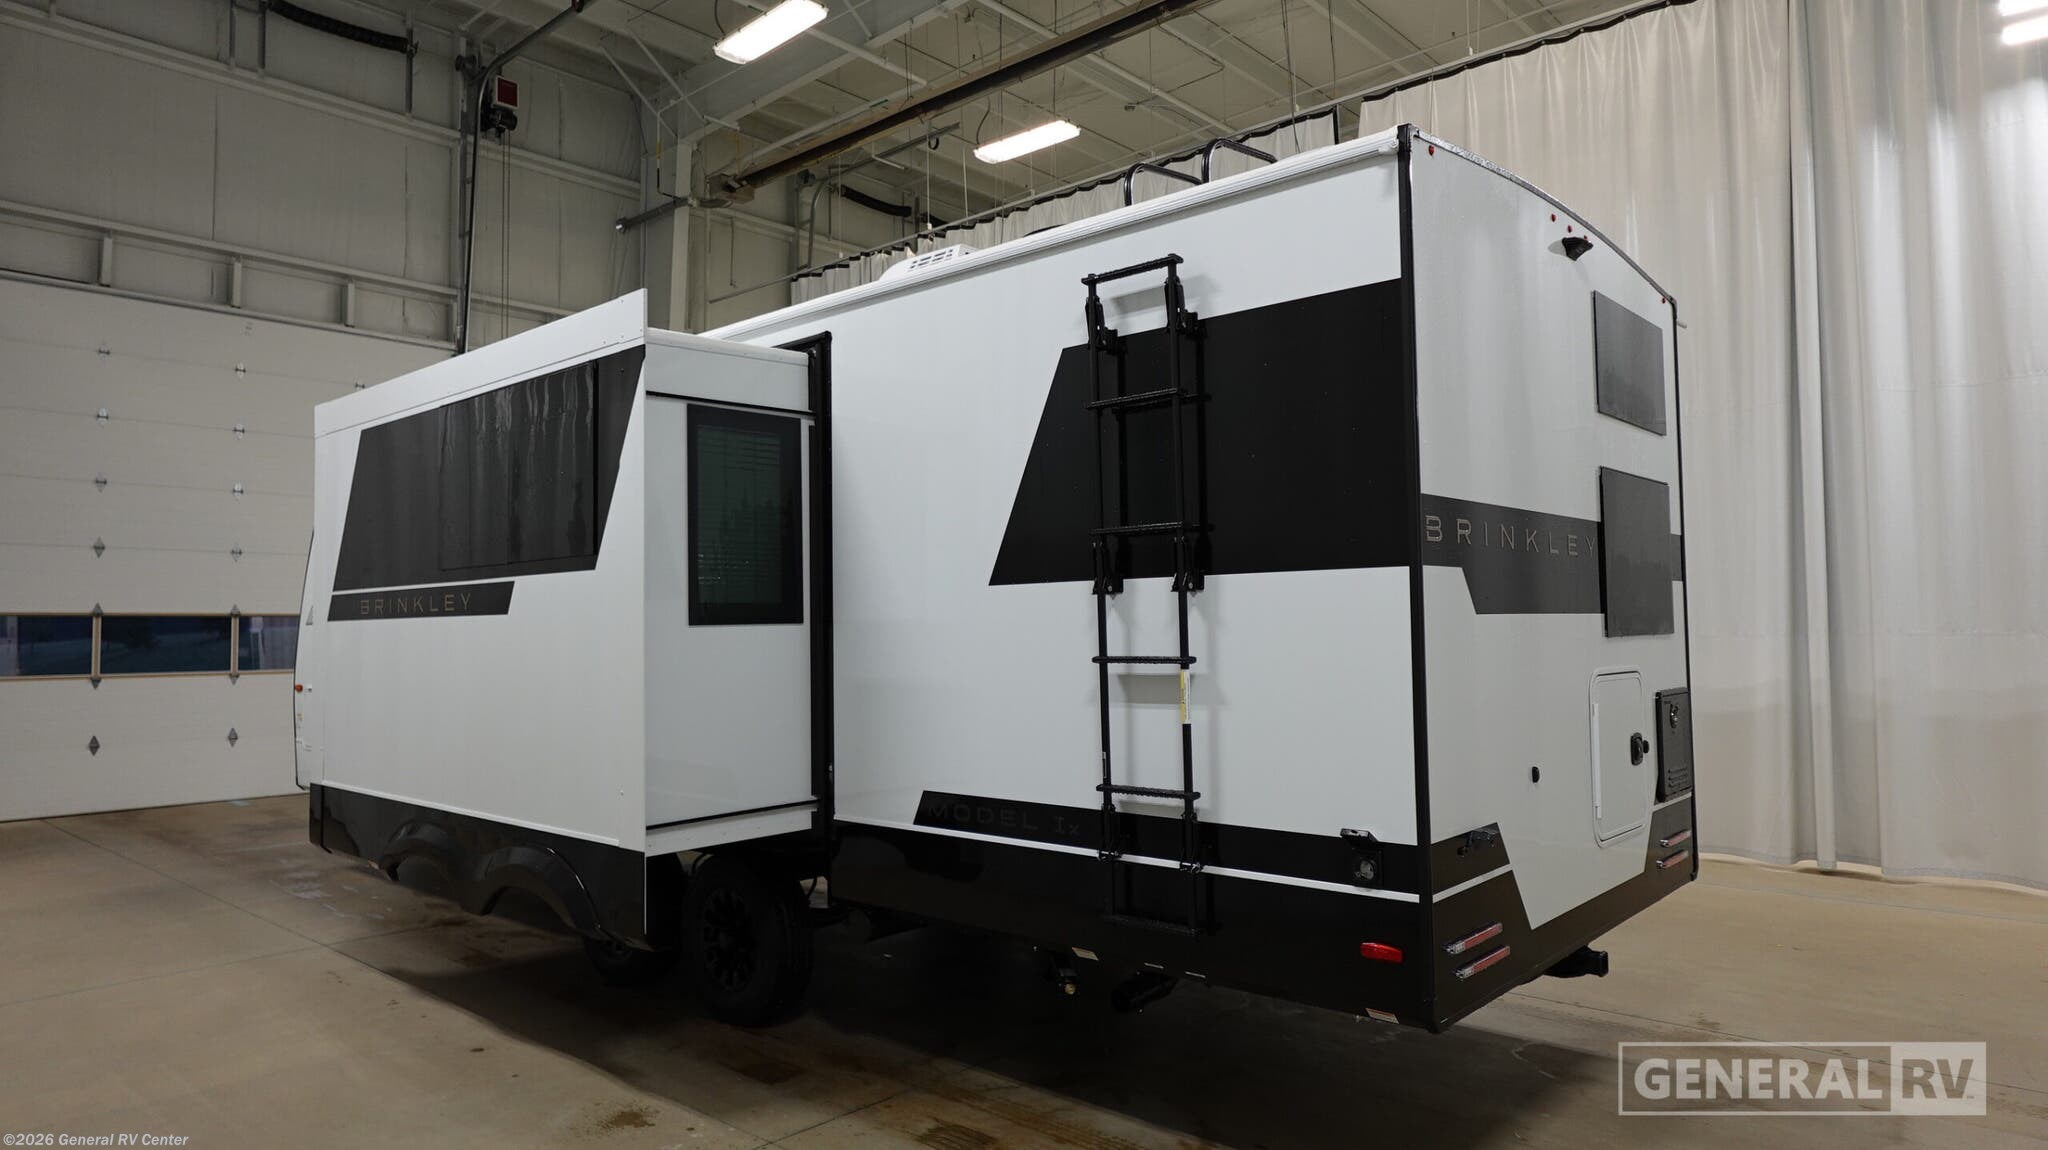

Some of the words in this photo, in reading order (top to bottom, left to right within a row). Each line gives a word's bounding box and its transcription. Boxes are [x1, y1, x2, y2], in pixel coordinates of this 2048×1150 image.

[1425, 515, 1596, 557] BRINKLEY
[360, 593, 472, 616] BRINKLEY
[927, 803, 1039, 831] MODEL
